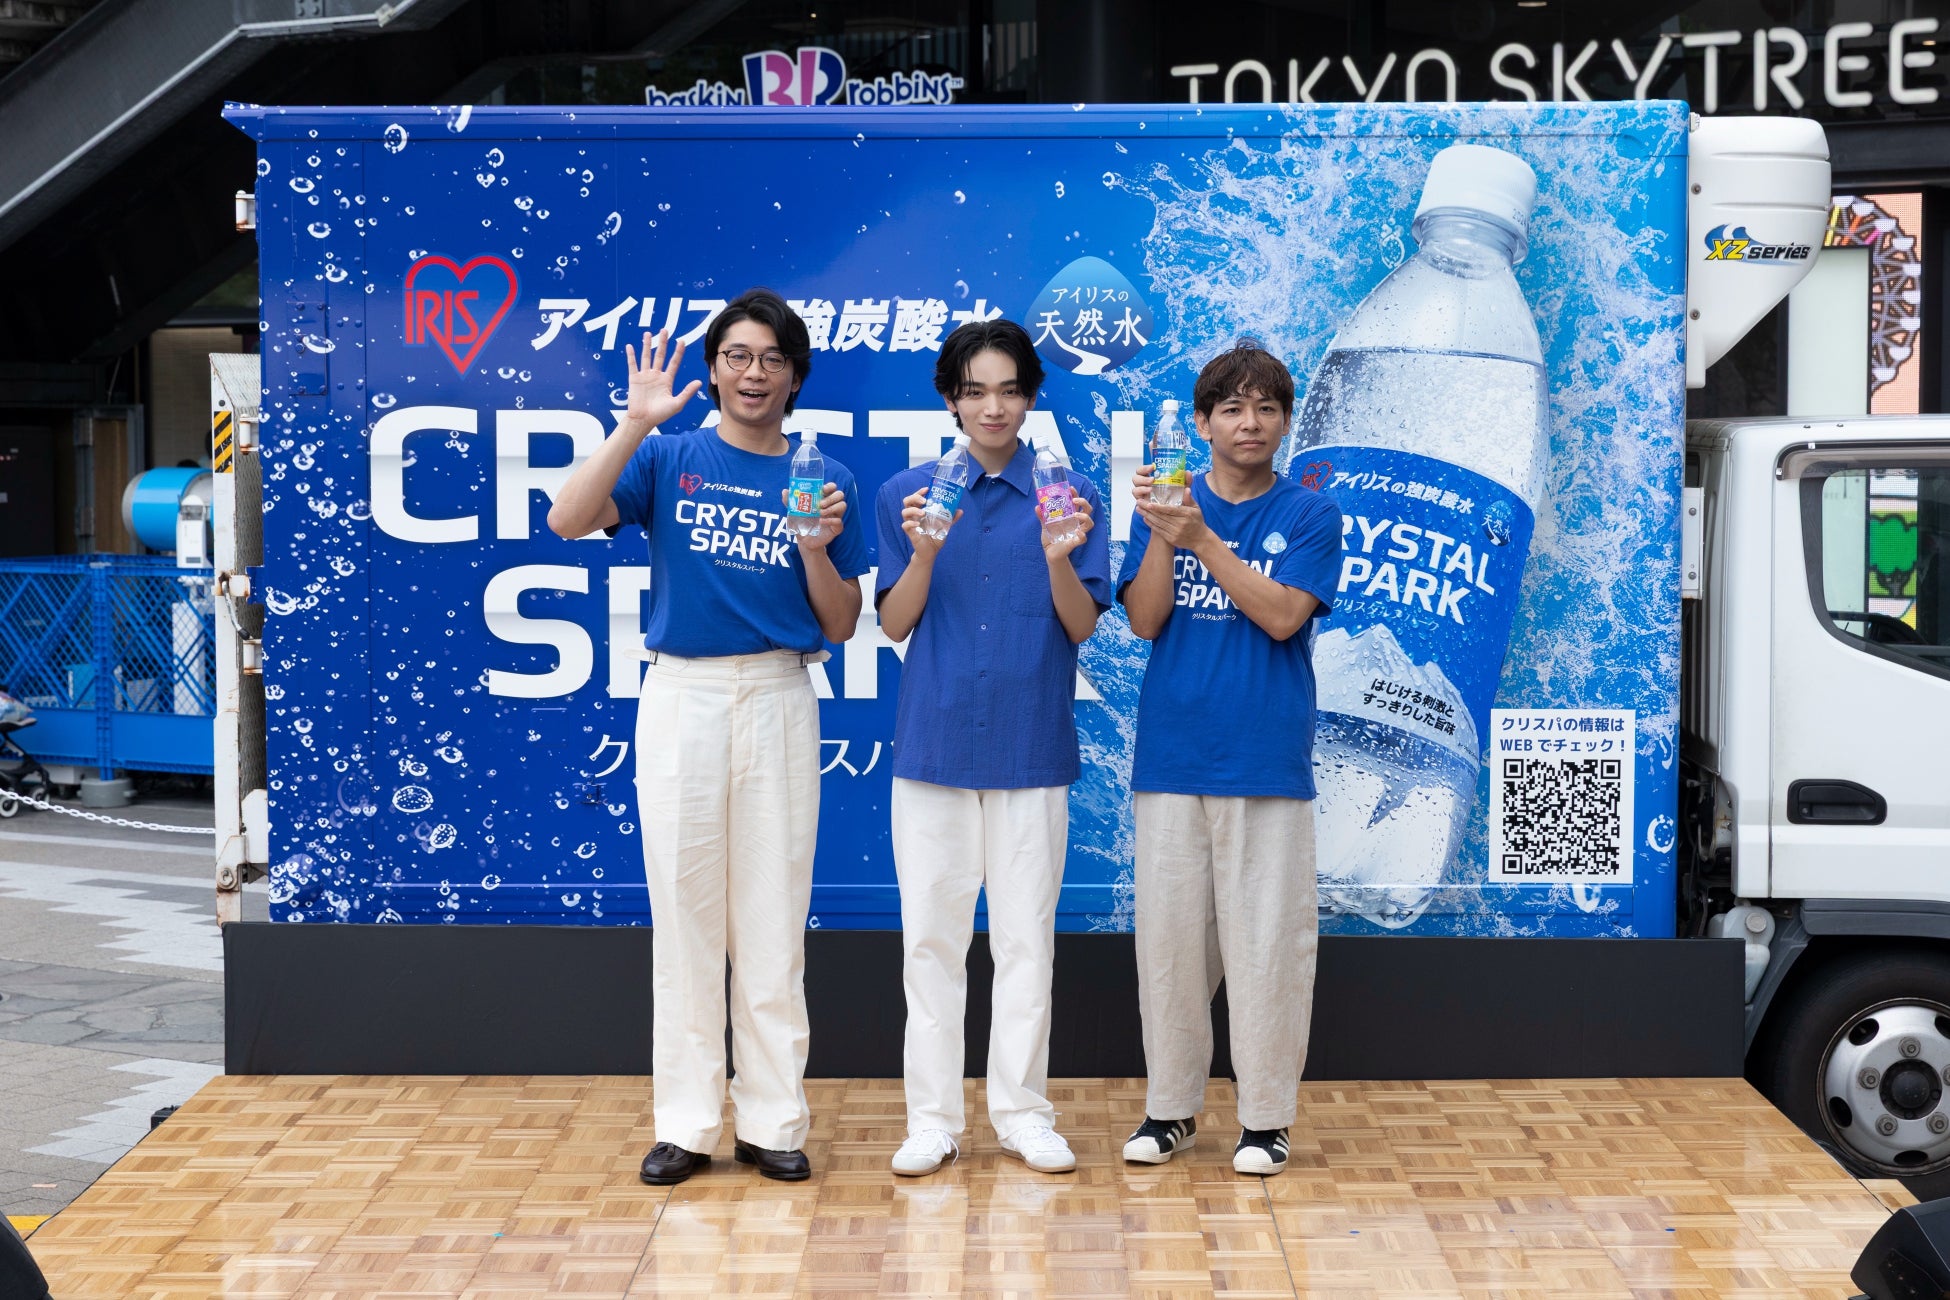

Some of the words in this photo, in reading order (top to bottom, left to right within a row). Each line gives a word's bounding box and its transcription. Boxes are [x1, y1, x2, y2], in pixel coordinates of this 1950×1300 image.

[1490, 18, 1940, 113] SKYTREE
[1704, 239, 1750, 260] XZ
[1747, 242, 1811, 260] series
[405, 289, 479, 345] IRIS
[1051, 286, 1129, 305] アイリスの
[1032, 306, 1149, 352] 天然水
[1330, 470, 1475, 514] アイリスの強炭酸水
[675, 500, 798, 544] CRYSTA
[690, 527, 791, 568] SPARK
[714, 559, 765, 574] クリスタルスパーク
[1342, 514, 1495, 596] RYSTAL
[1337, 556, 1471, 626] PARK
[1192, 613, 1237, 621] クリスタルスパーク
[1363, 693, 1456, 736] すっきりした旨味
[1371, 678, 1455, 718] はじける刺激と
[1501, 717, 1625, 732] クリスパの情報は
